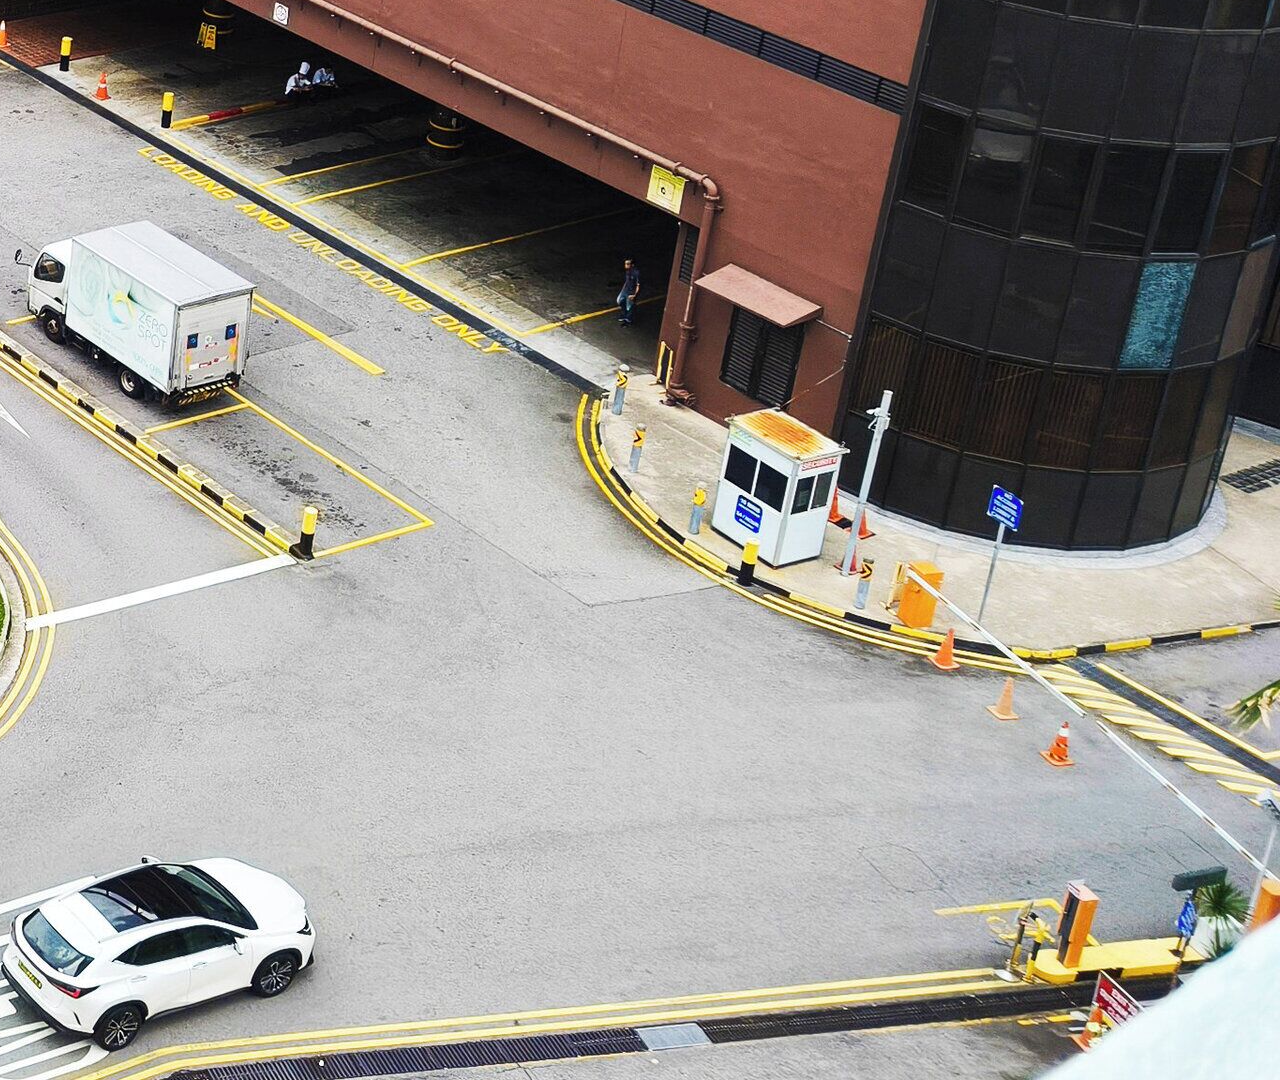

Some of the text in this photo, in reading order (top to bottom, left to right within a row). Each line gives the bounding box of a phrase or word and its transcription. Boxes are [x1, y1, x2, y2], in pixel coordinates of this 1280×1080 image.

[137, 146, 511, 355] LOADING AND UNLOADING ONLY
[137, 322, 168, 352] SPOT
[138, 310, 168, 338] ZERO
